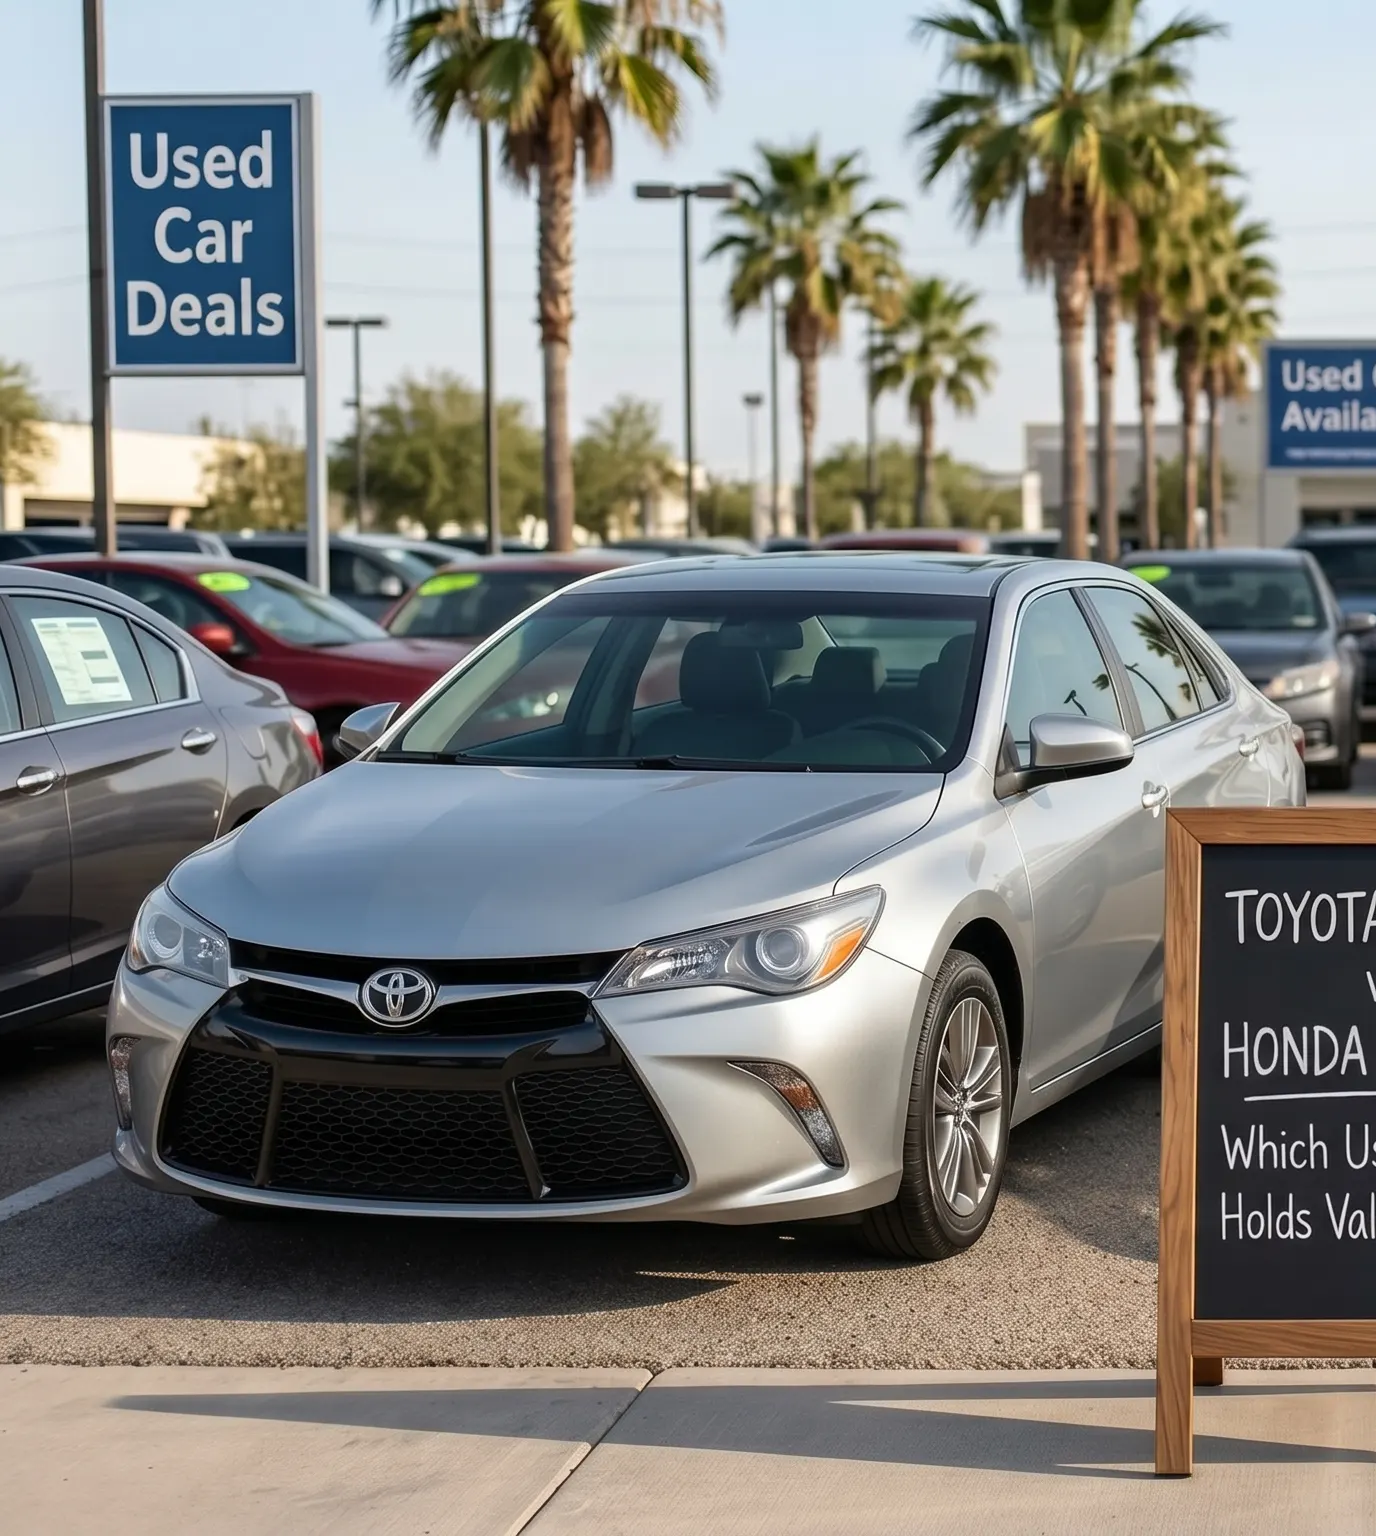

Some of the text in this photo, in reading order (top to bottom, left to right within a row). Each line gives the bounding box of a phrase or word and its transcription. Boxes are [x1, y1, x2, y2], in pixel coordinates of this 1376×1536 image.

[130, 129, 273, 190] Used
[154, 206, 253, 264] Car
[126, 277, 285, 337] Deals
[1281, 359, 1363, 392] Used
[1223, 1021, 1368, 1079] HONDA
[1220, 1123, 1328, 1170] Which
[1221, 1192, 1312, 1240] Holds
